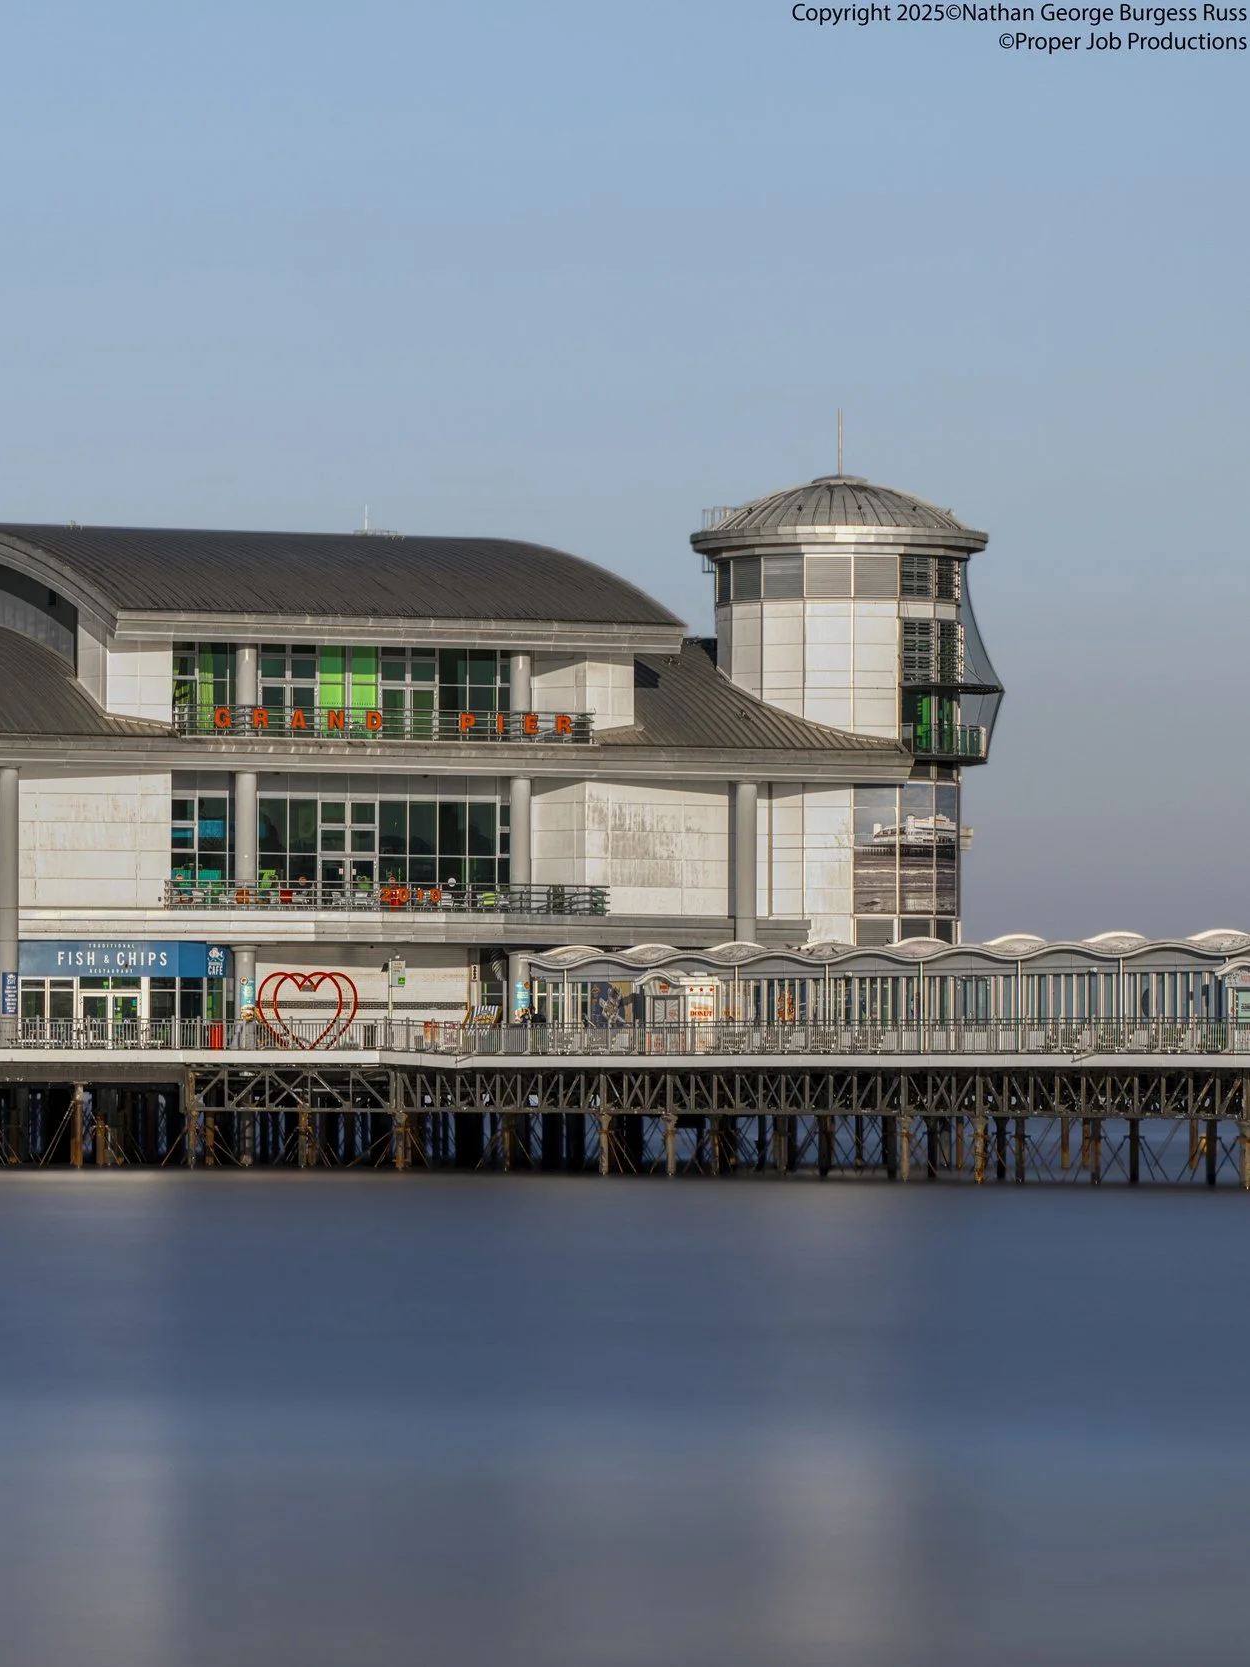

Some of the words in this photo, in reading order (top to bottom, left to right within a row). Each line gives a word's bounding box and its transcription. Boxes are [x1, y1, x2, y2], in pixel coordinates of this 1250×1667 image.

[213, 707, 383, 730] GRAND
[459, 713, 572, 735] PIER
[381, 887, 441, 903] 2010
[57, 951, 96, 966] FISH
[103, 954, 110, 964] &
[116, 951, 168, 966] CHIPS
